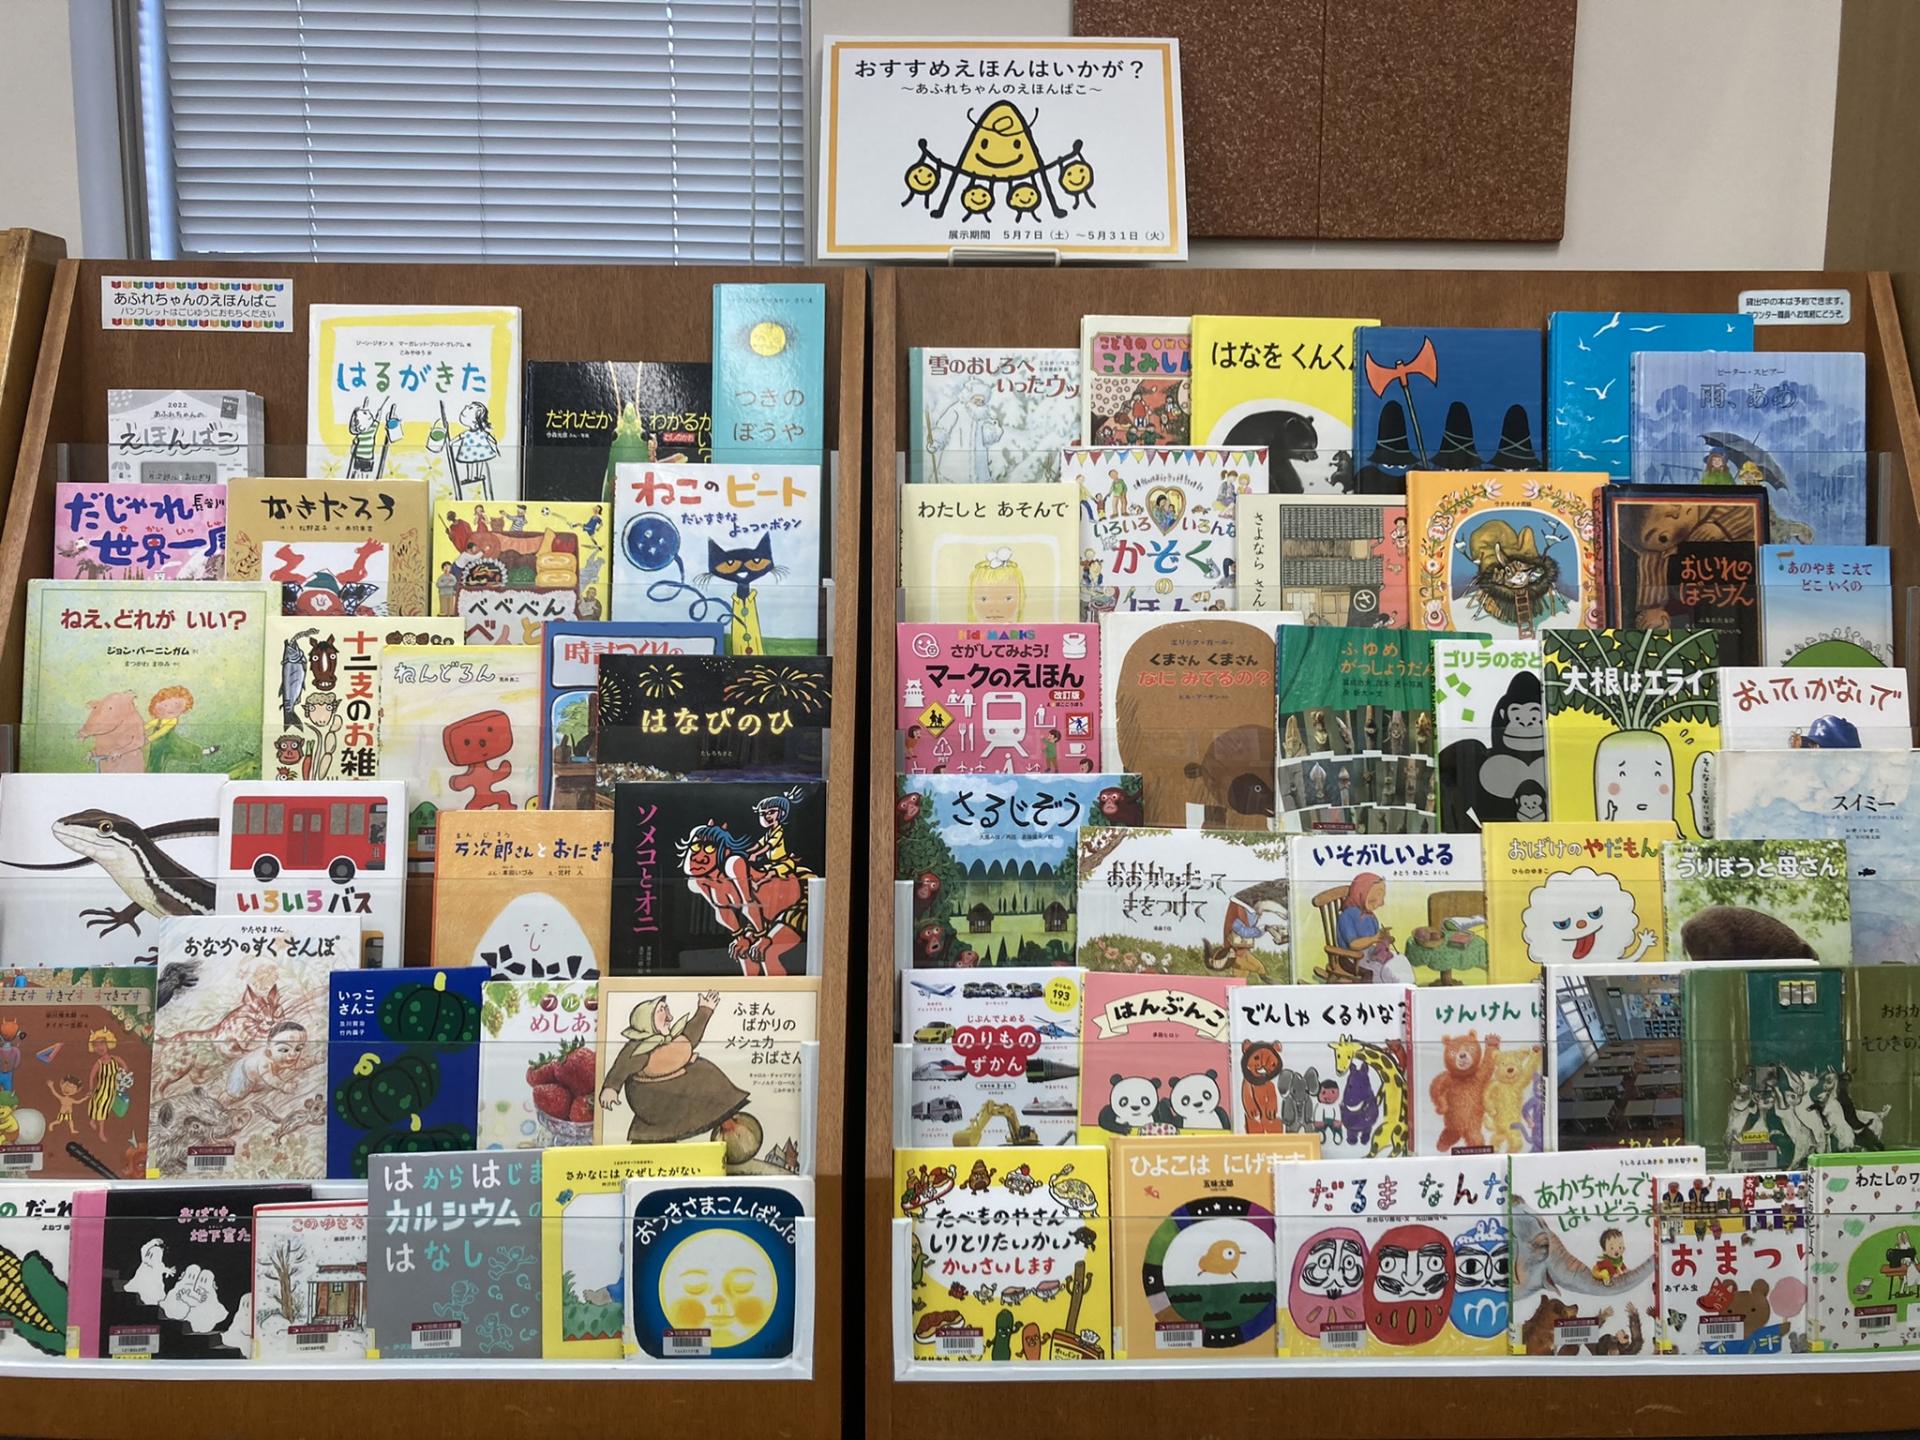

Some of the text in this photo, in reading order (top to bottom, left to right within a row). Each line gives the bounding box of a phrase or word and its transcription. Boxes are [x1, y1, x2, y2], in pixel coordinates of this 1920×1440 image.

[855, 58, 1145, 80] おすすめえほんはいかが？
[948, 229, 991, 241] 展示期間
[113, 291, 277, 308] あふれちゃんのえほんばこ
[120, 307, 276, 319] パンフレットはごじゆうにおもちください
[1100, 335, 1147, 351] こどもの
[928, 355, 1036, 376] 雪のおしろへ
[1211, 341, 1282, 369] はなを
[337, 361, 487, 393] はるがきた
[735, 388, 805, 409] つきの
[545, 409, 613, 430] だれだか
[120, 421, 239, 455] えほんばこ
[733, 421, 805, 443] ぼうや
[631, 471, 807, 508] ねこの ピート
[64, 491, 194, 532] だじゃれ
[681, 512, 738, 525] だいすきな
[918, 501, 1070, 519] わたしと あそんで
[729, 517, 802, 538] よっつのボタン
[1094, 517, 1151, 538] いろいろ
[1251, 512, 1265, 571] さよなら
[1112, 539, 1213, 574] かぞく
[1681, 554, 1753, 581] おしいれの
[1787, 561, 1873, 576] あのやま こえて
[1680, 581, 1754, 608] ぼうけん
[1801, 579, 1863, 592] どこ いくの
[60, 608, 247, 630] ねえ、どれが いい？
[106, 646, 190, 656] ジョン・バーニンガム
[951, 643, 1049, 658] さがしてみよう！
[1150, 653, 1258, 667] くまさん くまさん
[1341, 641, 1400, 657] ふゆめ
[1443, 651, 1543, 669] ゴリラのおと
[394, 661, 496, 684] ねんどろん
[925, 663, 1085, 689] マークのえほん
[1138, 670, 1271, 687] なに みてるの？
[1562, 667, 1704, 697] 大根はエライ
[1053, 691, 1081, 699] 改訂版
[1733, 676, 1902, 712] おいていかないで
[341, 631, 378, 780] 十二支のお雑
[641, 707, 794, 737] はなびのひ
[951, 790, 1081, 828] さるじぞう
[1832, 794, 1896, 812] スイミー
[553, 838, 614, 862] おにぎ
[1312, 843, 1454, 867] いそがしいよる
[1508, 837, 1657, 860] おばけのやだもん
[633, 804, 661, 935] ソメコとオニ
[1107, 860, 1227, 893] おおかみだって
[1677, 856, 1839, 880] うりぼうと母さん
[236, 886, 373, 914] いろいろ バス
[1122, 892, 1208, 922] きをつけて
[184, 934, 342, 958] おなかのすく さんぽ
[338, 989, 375, 1001] いっこ
[1052, 989, 1070, 1001] 193
[338, 1002, 375, 1015] さんこ
[733, 1002, 776, 1016] ふまん
[967, 1014, 1026, 1023] じぶんでよめる
[1115, 994, 1225, 1028] はんぶんこ
[1241, 1002, 1310, 1027] でんしゃ
[1435, 1001, 1521, 1025] けんけん
[530, 1014, 598, 1034] めしあ
[742, 1018, 796, 1032] ばかりの
[1904, 1021, 1912, 1033] と
[724, 1035, 775, 1049] メシュカ
[957, 1031, 1036, 1049] のりもの
[1862, 1035, 1920, 1052] 七ひきの
[751, 1051, 802, 1065] おばさん
[971, 1056, 1023, 1072] ずかん
[565, 1166, 701, 1180] さかなには なぜしたがない
[1130, 1153, 1210, 1176] ひよこは
[384, 1161, 414, 1192] は
[422, 1164, 464, 1190] から
[1308, 1175, 1399, 1214] だるま
[1534, 1171, 1653, 1210] あかちゃんで
[177, 1206, 237, 1224] おばけの
[385, 1197, 522, 1235] カルシウム
[936, 1207, 1065, 1229] たべものやさん
[929, 1232, 1071, 1254] しりとりたいかい
[386, 1239, 484, 1273] はなし
[942, 1257, 1056, 1275] かいさいします
